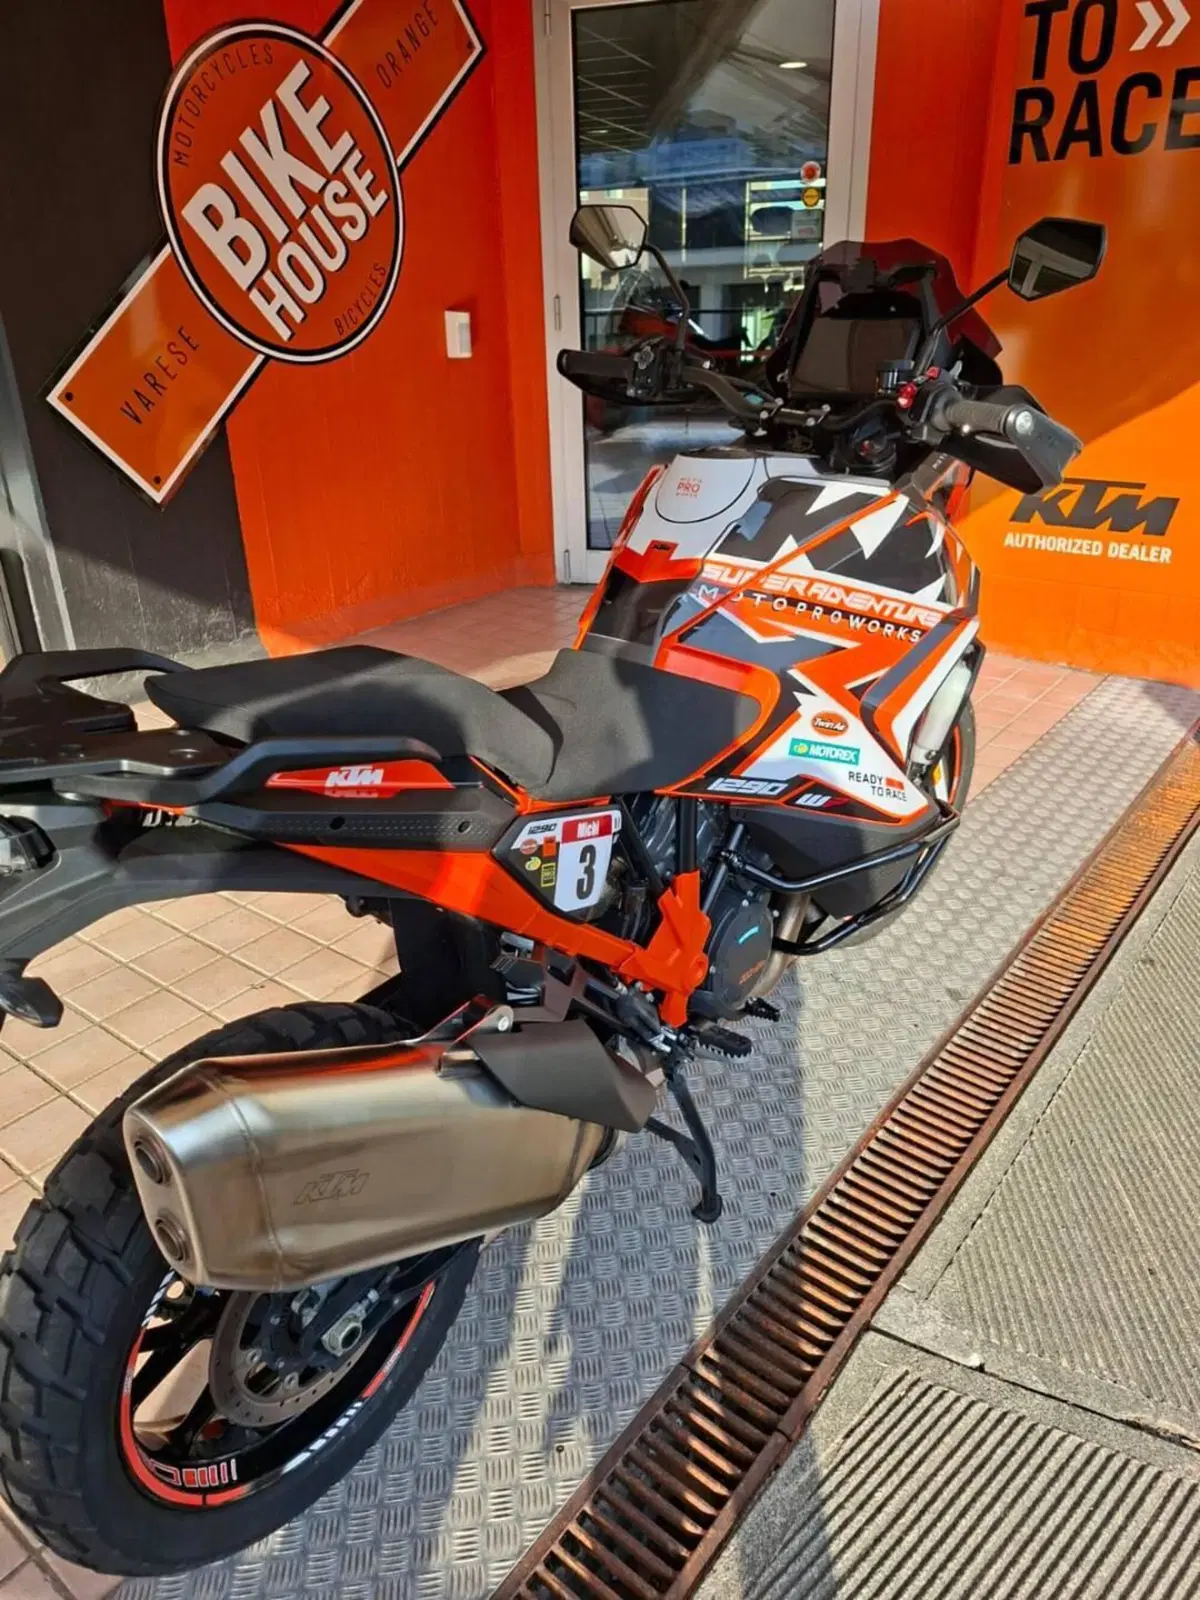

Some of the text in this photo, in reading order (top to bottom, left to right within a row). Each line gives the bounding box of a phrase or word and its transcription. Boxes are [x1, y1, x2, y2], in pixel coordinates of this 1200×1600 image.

[376, 0, 439, 89] ORANGE
[1024, 0, 1118, 80] TO
[173, 43, 274, 168] MOTORCYCLES
[1008, 66, 1200, 165] RACE
[181, 60, 356, 292] BIKE
[248, 148, 389, 341] HOUSE
[333, 262, 387, 336] BICYCLES
[119, 325, 200, 425] VARESE
[677, 482, 700, 493] PRO
[1008, 477, 1180, 536] KTM
[1003, 532, 1172, 564] AUTHORIZED DEALER
[325, 764, 384, 788] KTM
[810, 744, 858, 764] MOTOREX
[848, 770, 883, 786] READY
[706, 777, 789, 796] 1290
[871, 785, 884, 797] TO
[528, 822, 557, 835] 1290
[576, 844, 597, 900] 3
[293, 1168, 370, 1206] KTM
